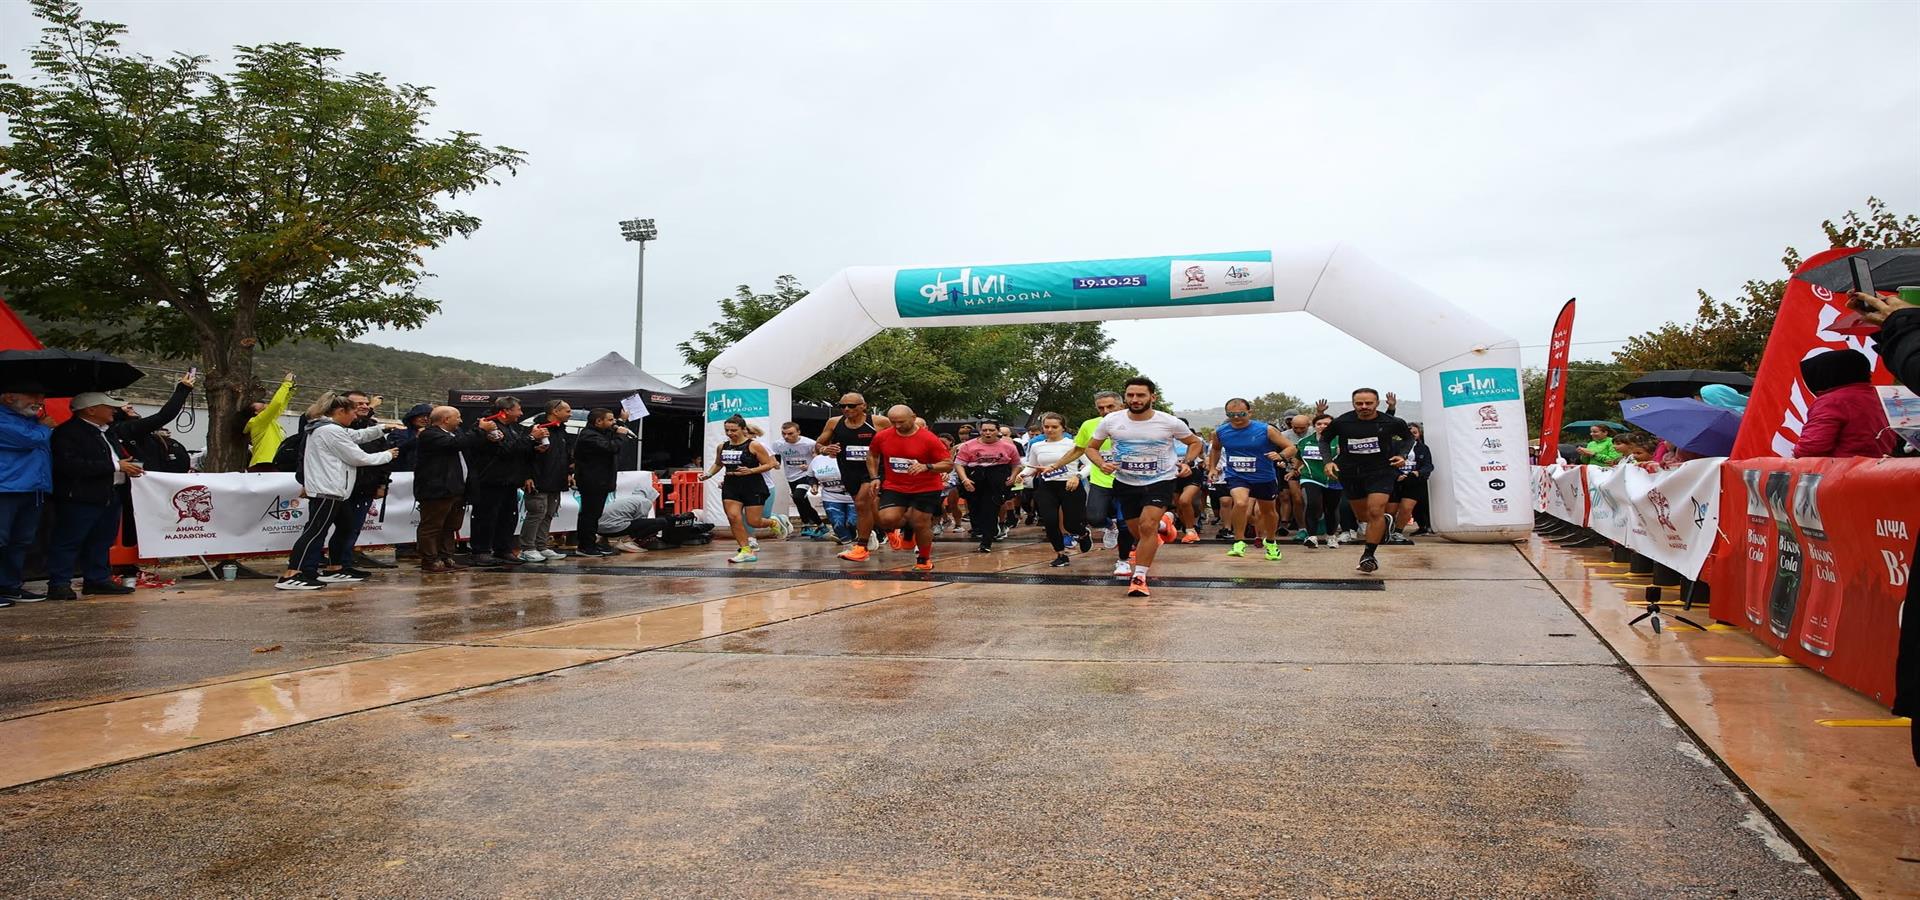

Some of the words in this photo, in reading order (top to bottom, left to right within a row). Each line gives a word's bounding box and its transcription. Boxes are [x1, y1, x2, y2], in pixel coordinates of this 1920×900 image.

[1079, 277, 1141, 288] 19.10.25
[1127, 462, 1151, 470] 5165
[164, 532, 217, 540] ΜΑΡΑΘΩΝΟΣ
[1876, 518, 1909, 540] ΔΙΨΑ
[1748, 547, 1764, 562] Cola
[1780, 555, 1799, 572] Cola
[1816, 564, 1837, 583] Cola
